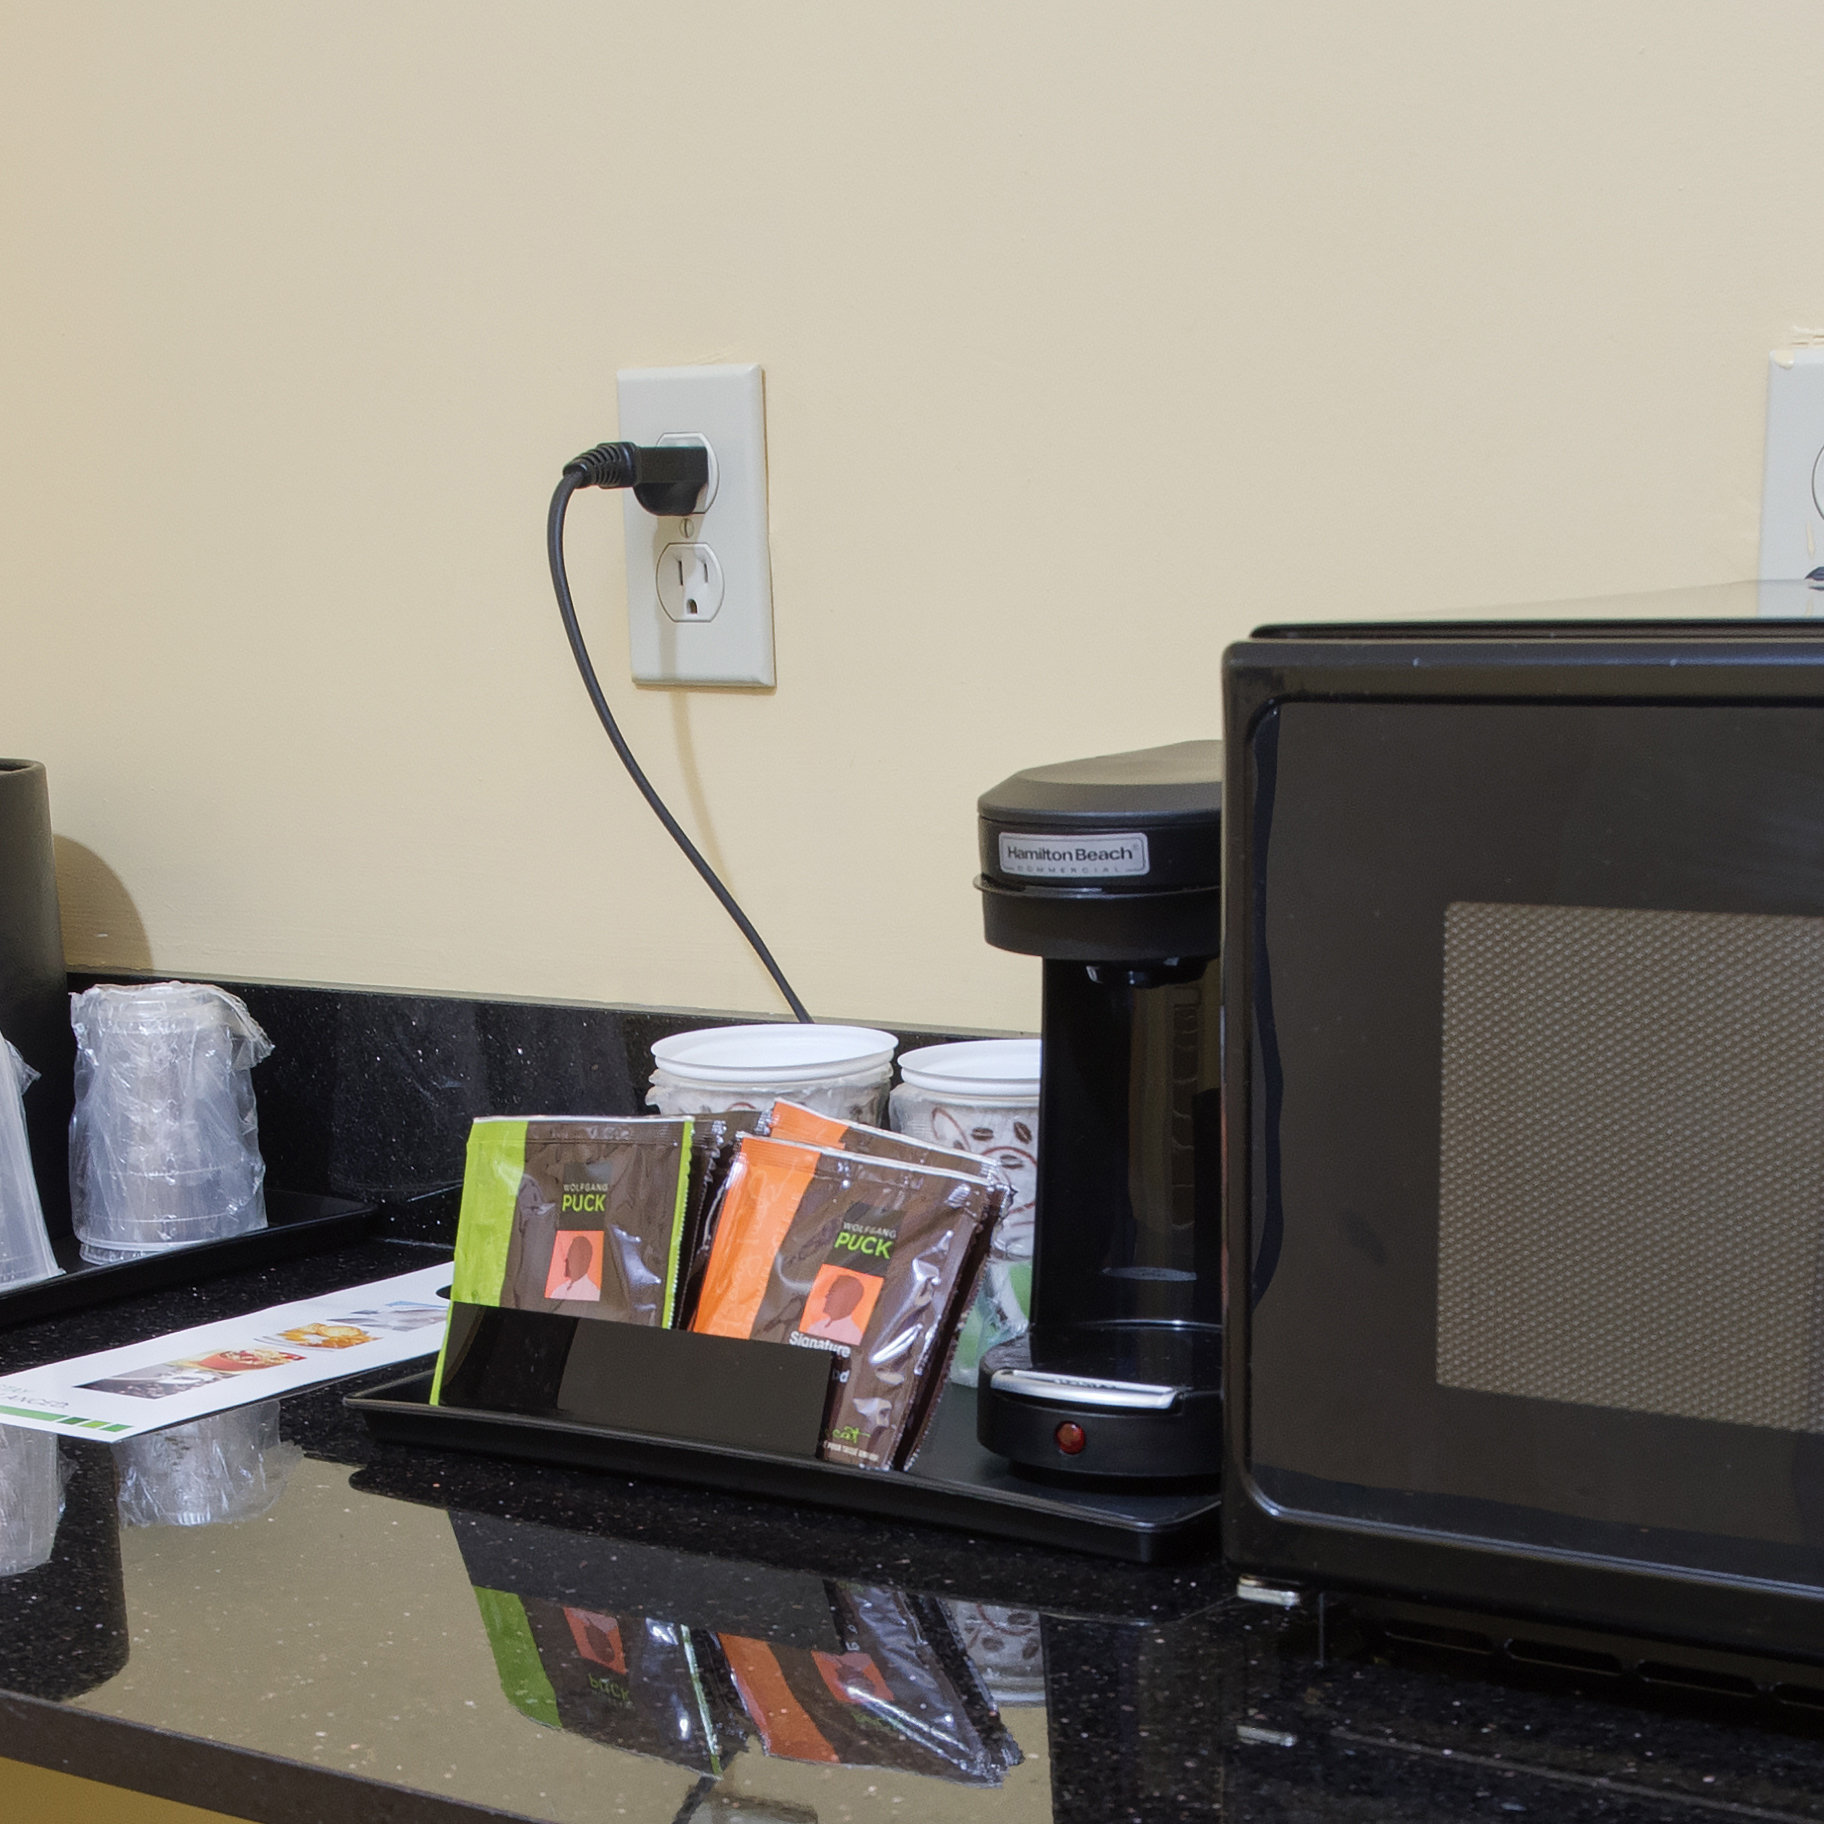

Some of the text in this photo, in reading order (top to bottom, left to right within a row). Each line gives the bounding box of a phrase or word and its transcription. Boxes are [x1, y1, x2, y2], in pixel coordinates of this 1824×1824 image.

[1007, 846, 1133, 862] Hamilton Beach
[1017, 865, 1120, 874] COMMERCIAL
[562, 1183, 609, 1192] WOLFGANG
[561, 1193, 607, 1212] PUCK
[843, 1221, 897, 1239] WOLFGANG
[834, 1231, 894, 1260] PUCK
[789, 1330, 851, 1358] Signature
